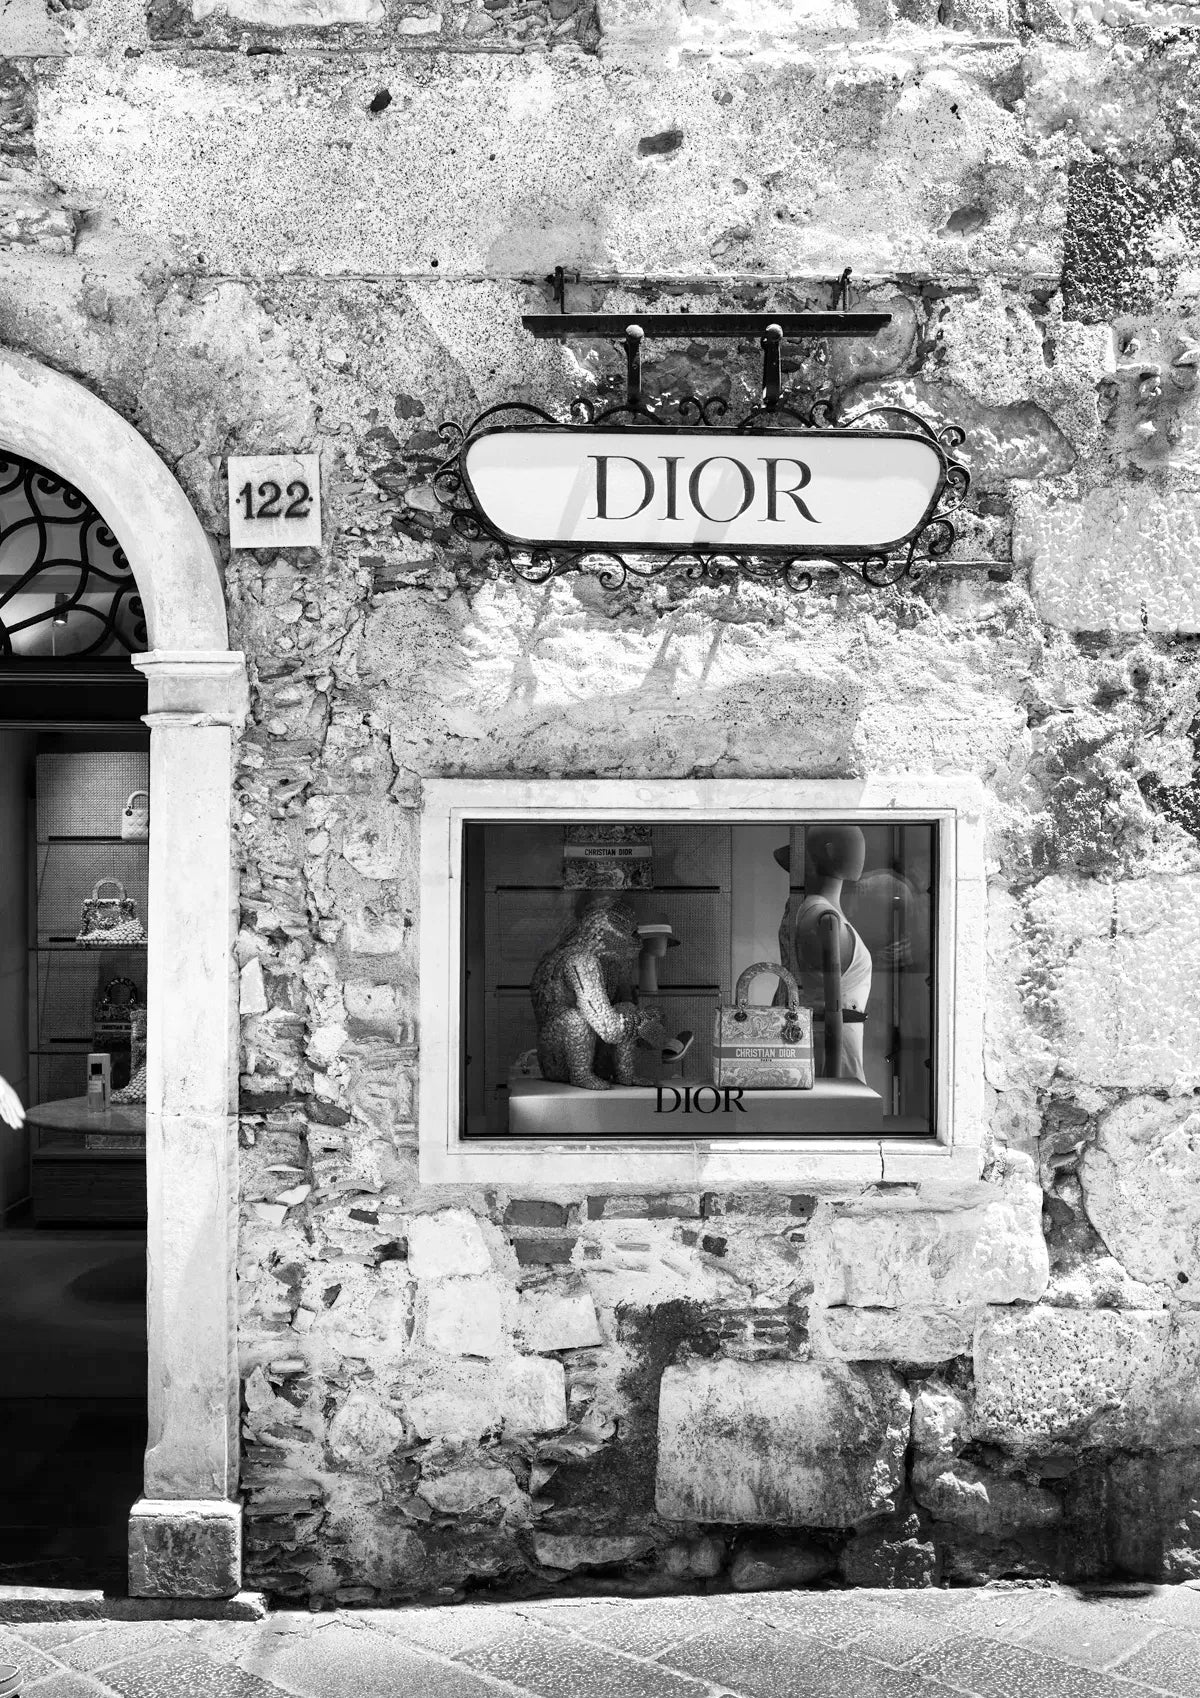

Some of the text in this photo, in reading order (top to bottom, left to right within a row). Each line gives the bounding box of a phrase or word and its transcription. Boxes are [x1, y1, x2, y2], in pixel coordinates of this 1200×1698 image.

[239, 481, 311, 519] 122
[586, 455, 822, 524] DIOR
[584, 848, 633, 856] CHRISTIAN DIOR
[735, 1048, 797, 1058] CHRISTIAN DIOR
[653, 1086, 748, 1114] DIOR
